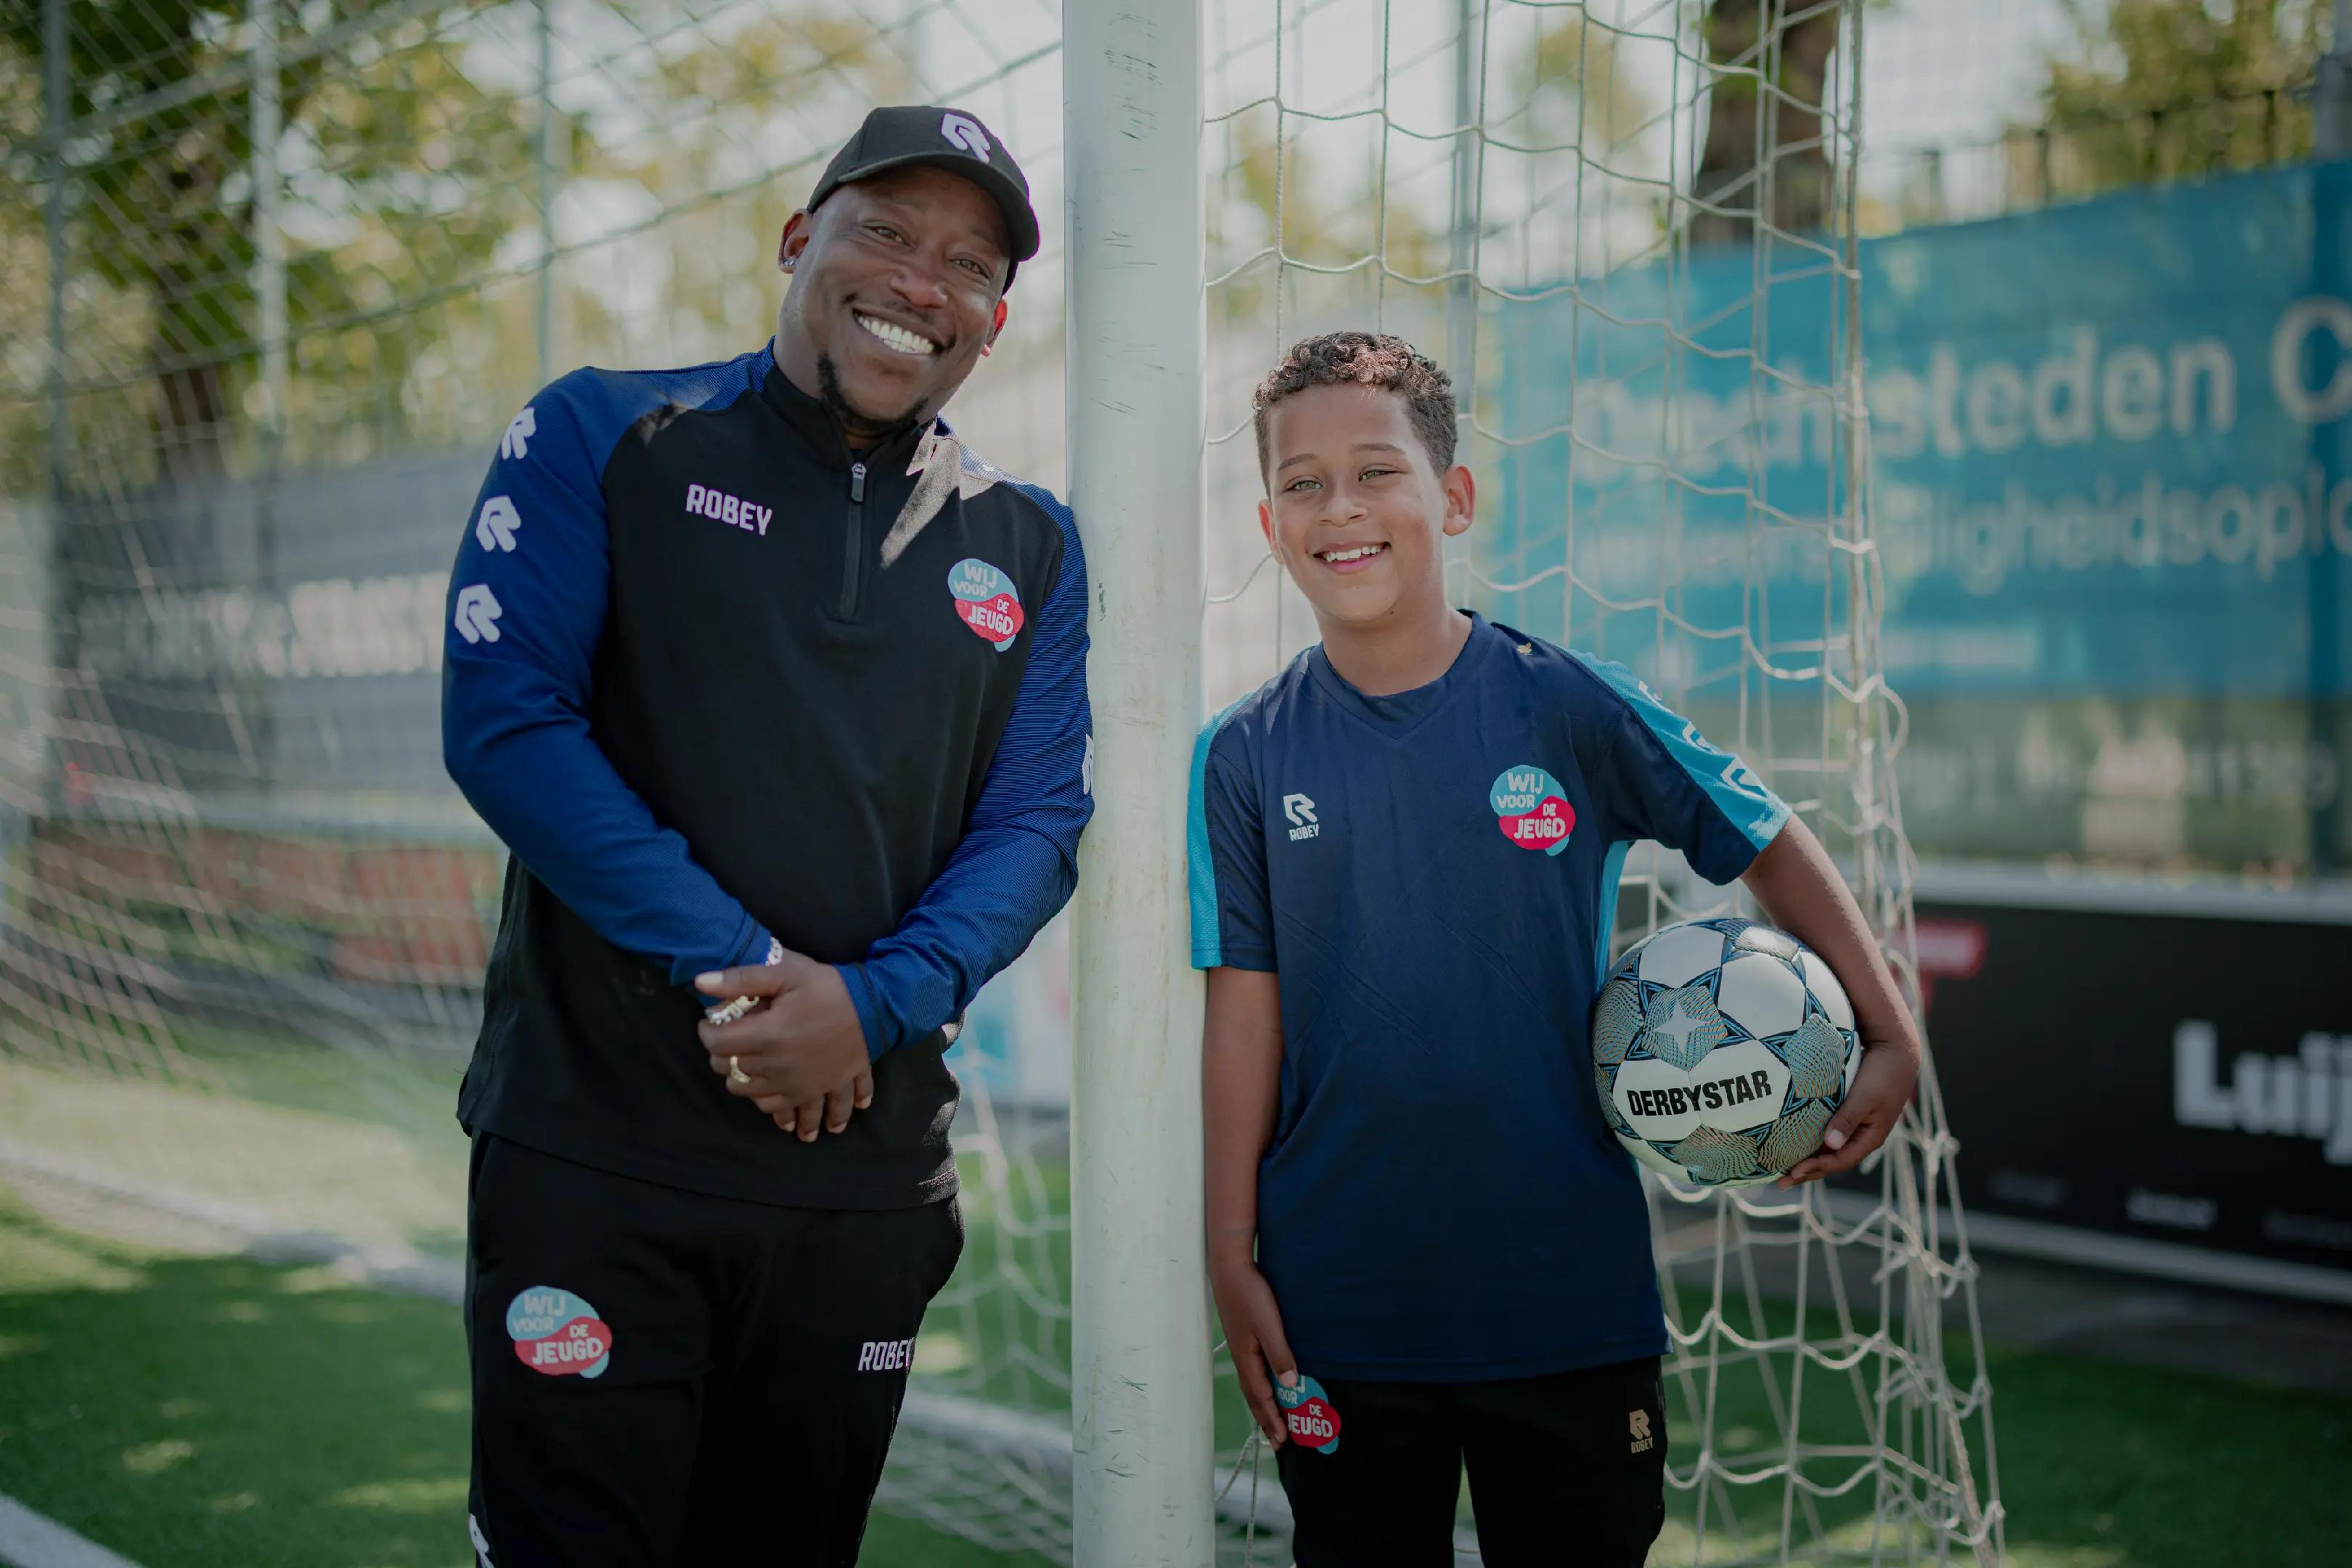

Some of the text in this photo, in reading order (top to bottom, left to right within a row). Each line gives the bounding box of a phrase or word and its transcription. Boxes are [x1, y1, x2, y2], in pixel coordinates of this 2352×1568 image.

[685, 483, 773, 536] ROBEY
[964, 562, 997, 589] WIJ
[953, 579, 987, 598] VOOR
[997, 598, 1010, 614] DE
[967, 604, 1014, 635] JEUGD
[1507, 772, 1543, 795] WIJ
[1495, 794, 1535, 809] VOOR
[1543, 803, 1557, 817] DE
[1289, 823, 1320, 841] ROBEY
[1514, 817, 1566, 839] JEUGD
[1626, 1069, 1773, 1116] DERBYSTAR
[524, 1293, 566, 1318] WIJ
[513, 1316, 554, 1333] VOOR
[569, 1323, 589, 1339] DE
[531, 1337, 604, 1365] JEUGD
[1309, 1403, 1323, 1418] DE
